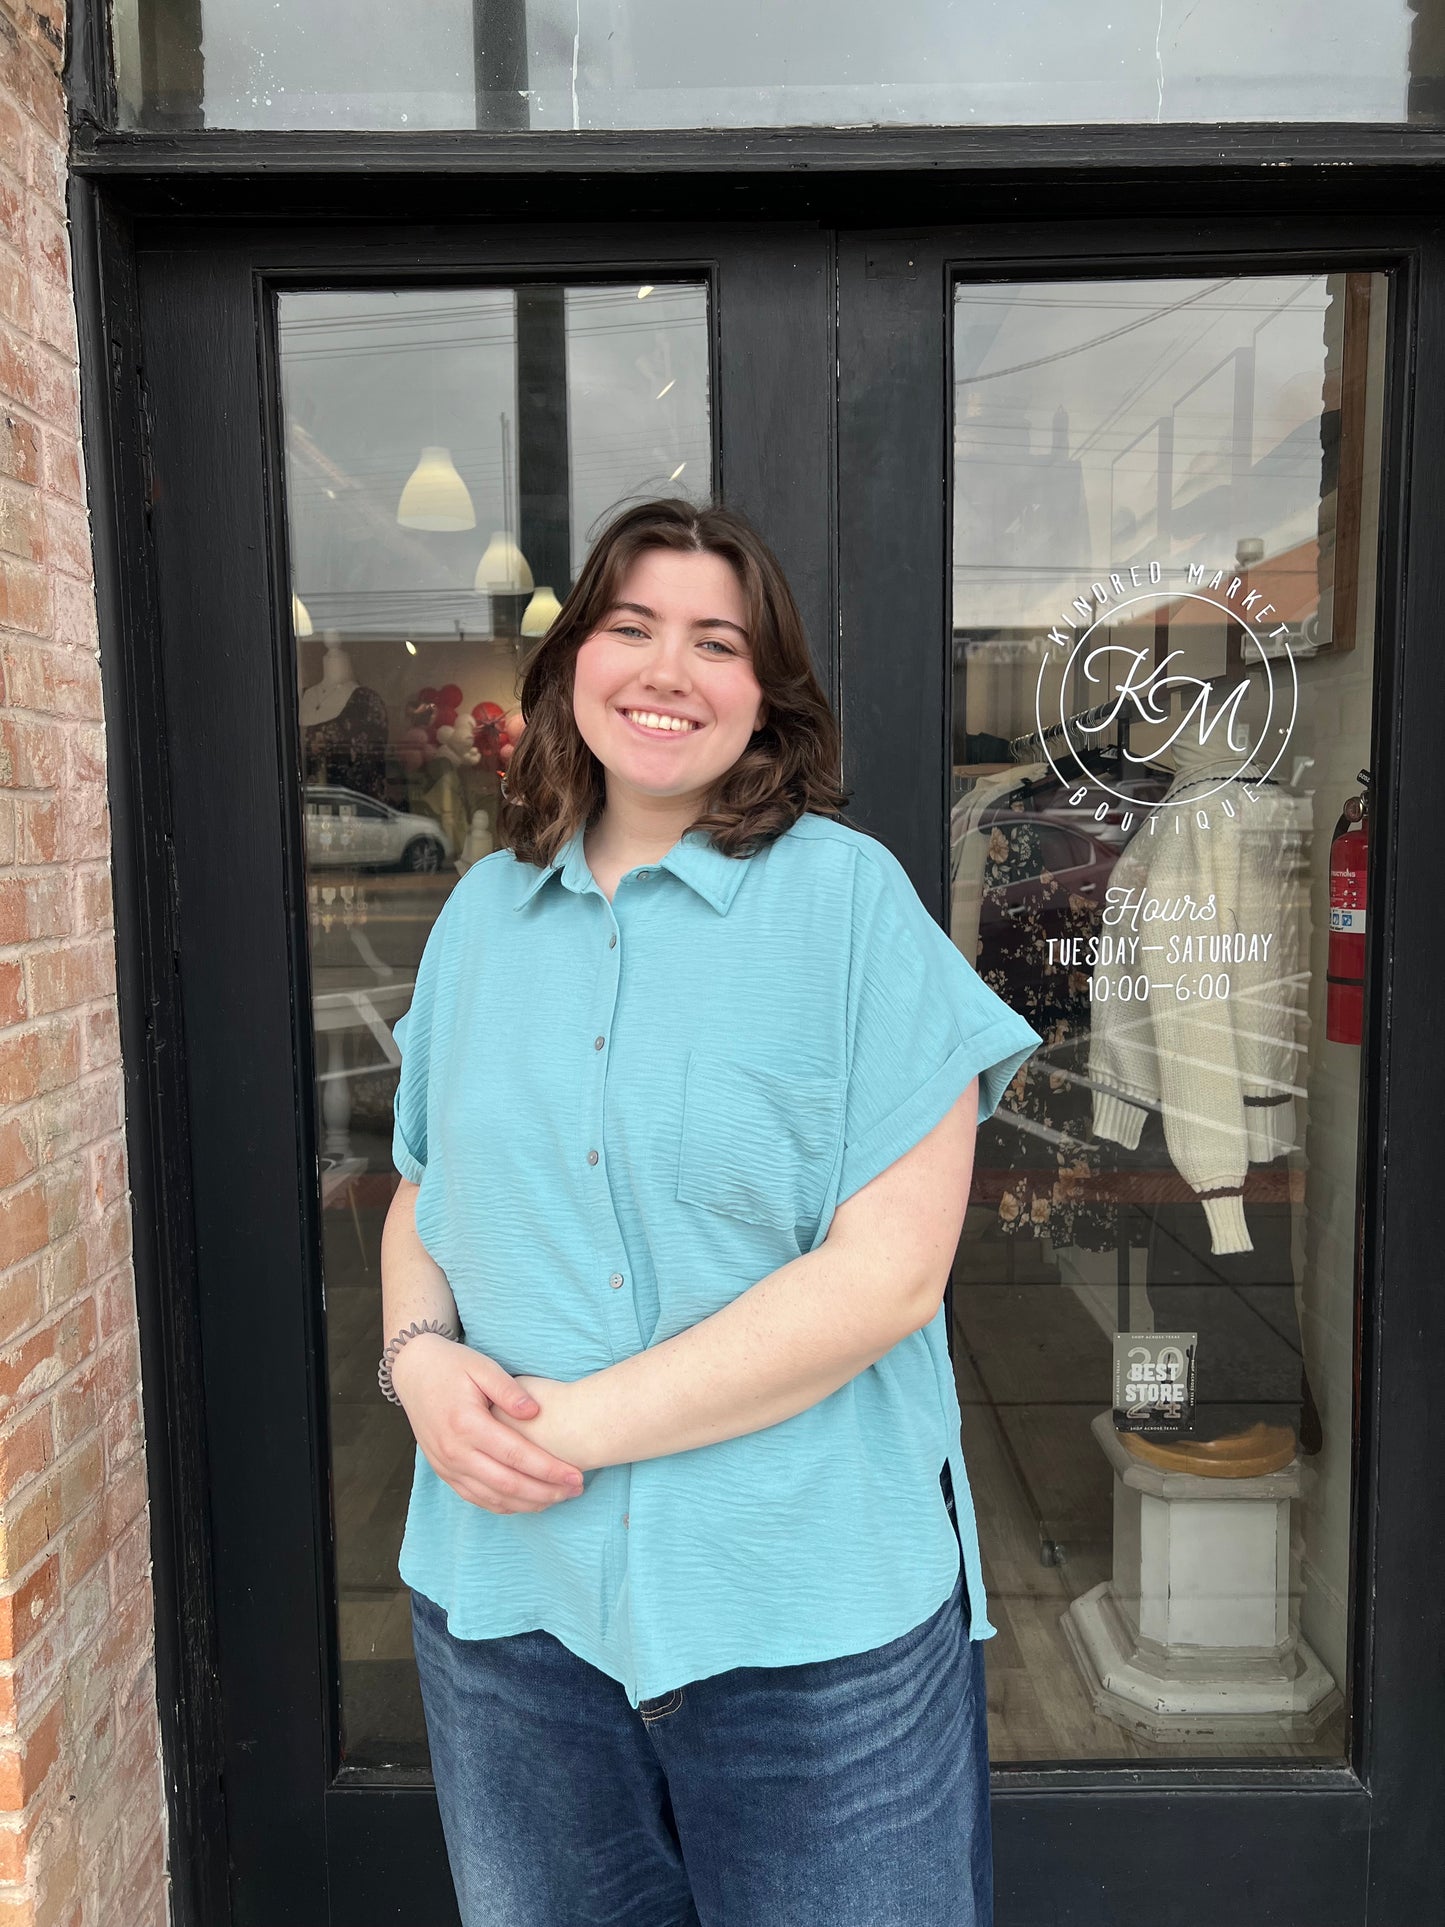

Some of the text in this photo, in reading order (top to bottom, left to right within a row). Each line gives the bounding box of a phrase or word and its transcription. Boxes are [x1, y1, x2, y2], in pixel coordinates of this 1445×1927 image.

[1047, 561, 1290, 646] KINDRED MARKET
[1075, 645, 1251, 763] KM
[1068, 783, 1261, 836] BOUTIQUE
[1102, 886, 1217, 932] Hours
[1125, 1383, 1185, 1402] STORE
[1131, 1363, 1180, 1381] BEST
